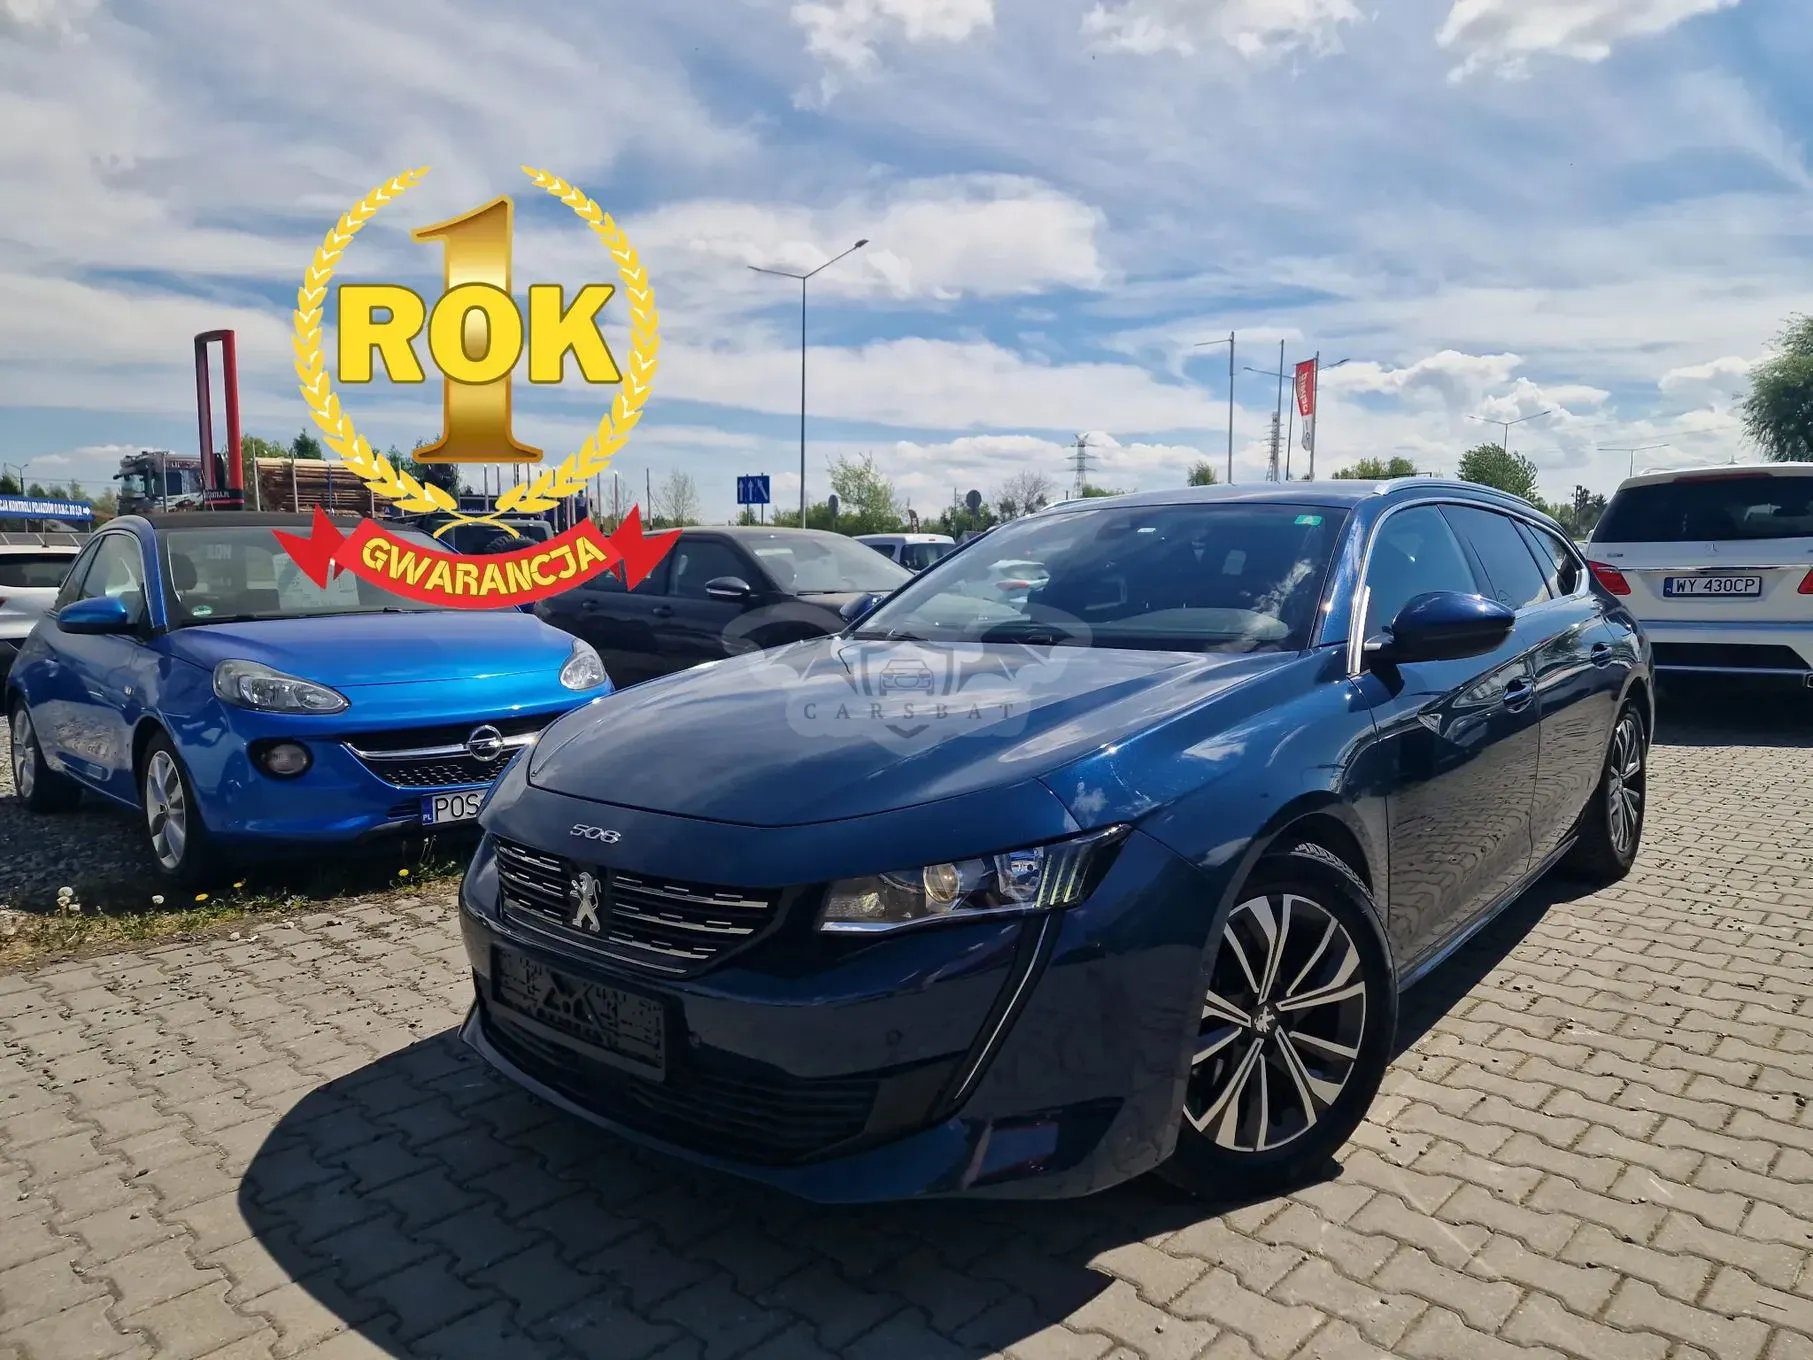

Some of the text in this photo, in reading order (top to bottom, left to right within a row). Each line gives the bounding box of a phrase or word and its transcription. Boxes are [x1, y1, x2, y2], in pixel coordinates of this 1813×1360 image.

[1676, 579, 1755, 592] WY 430CP
[435, 794, 479, 821] POS
[570, 823, 621, 844] 508
